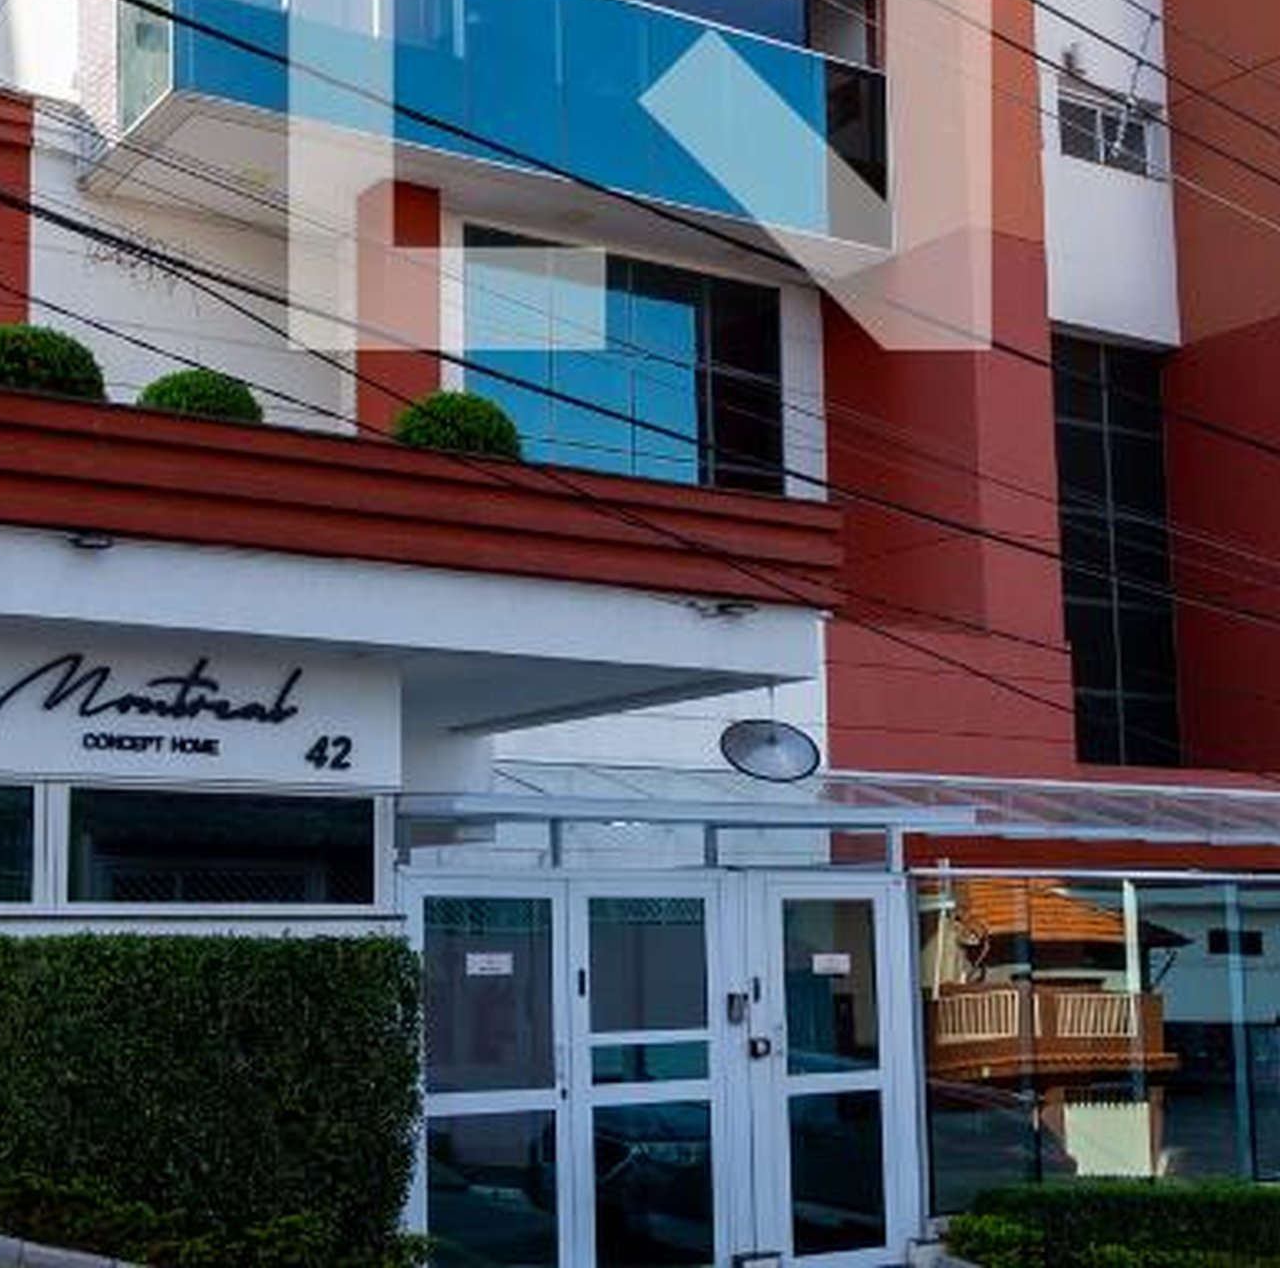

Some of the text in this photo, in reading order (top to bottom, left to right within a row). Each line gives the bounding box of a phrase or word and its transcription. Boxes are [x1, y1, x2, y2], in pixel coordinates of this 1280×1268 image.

[82, 732, 220, 756] CONCEPT HOME
[305, 736, 352, 770] 42
